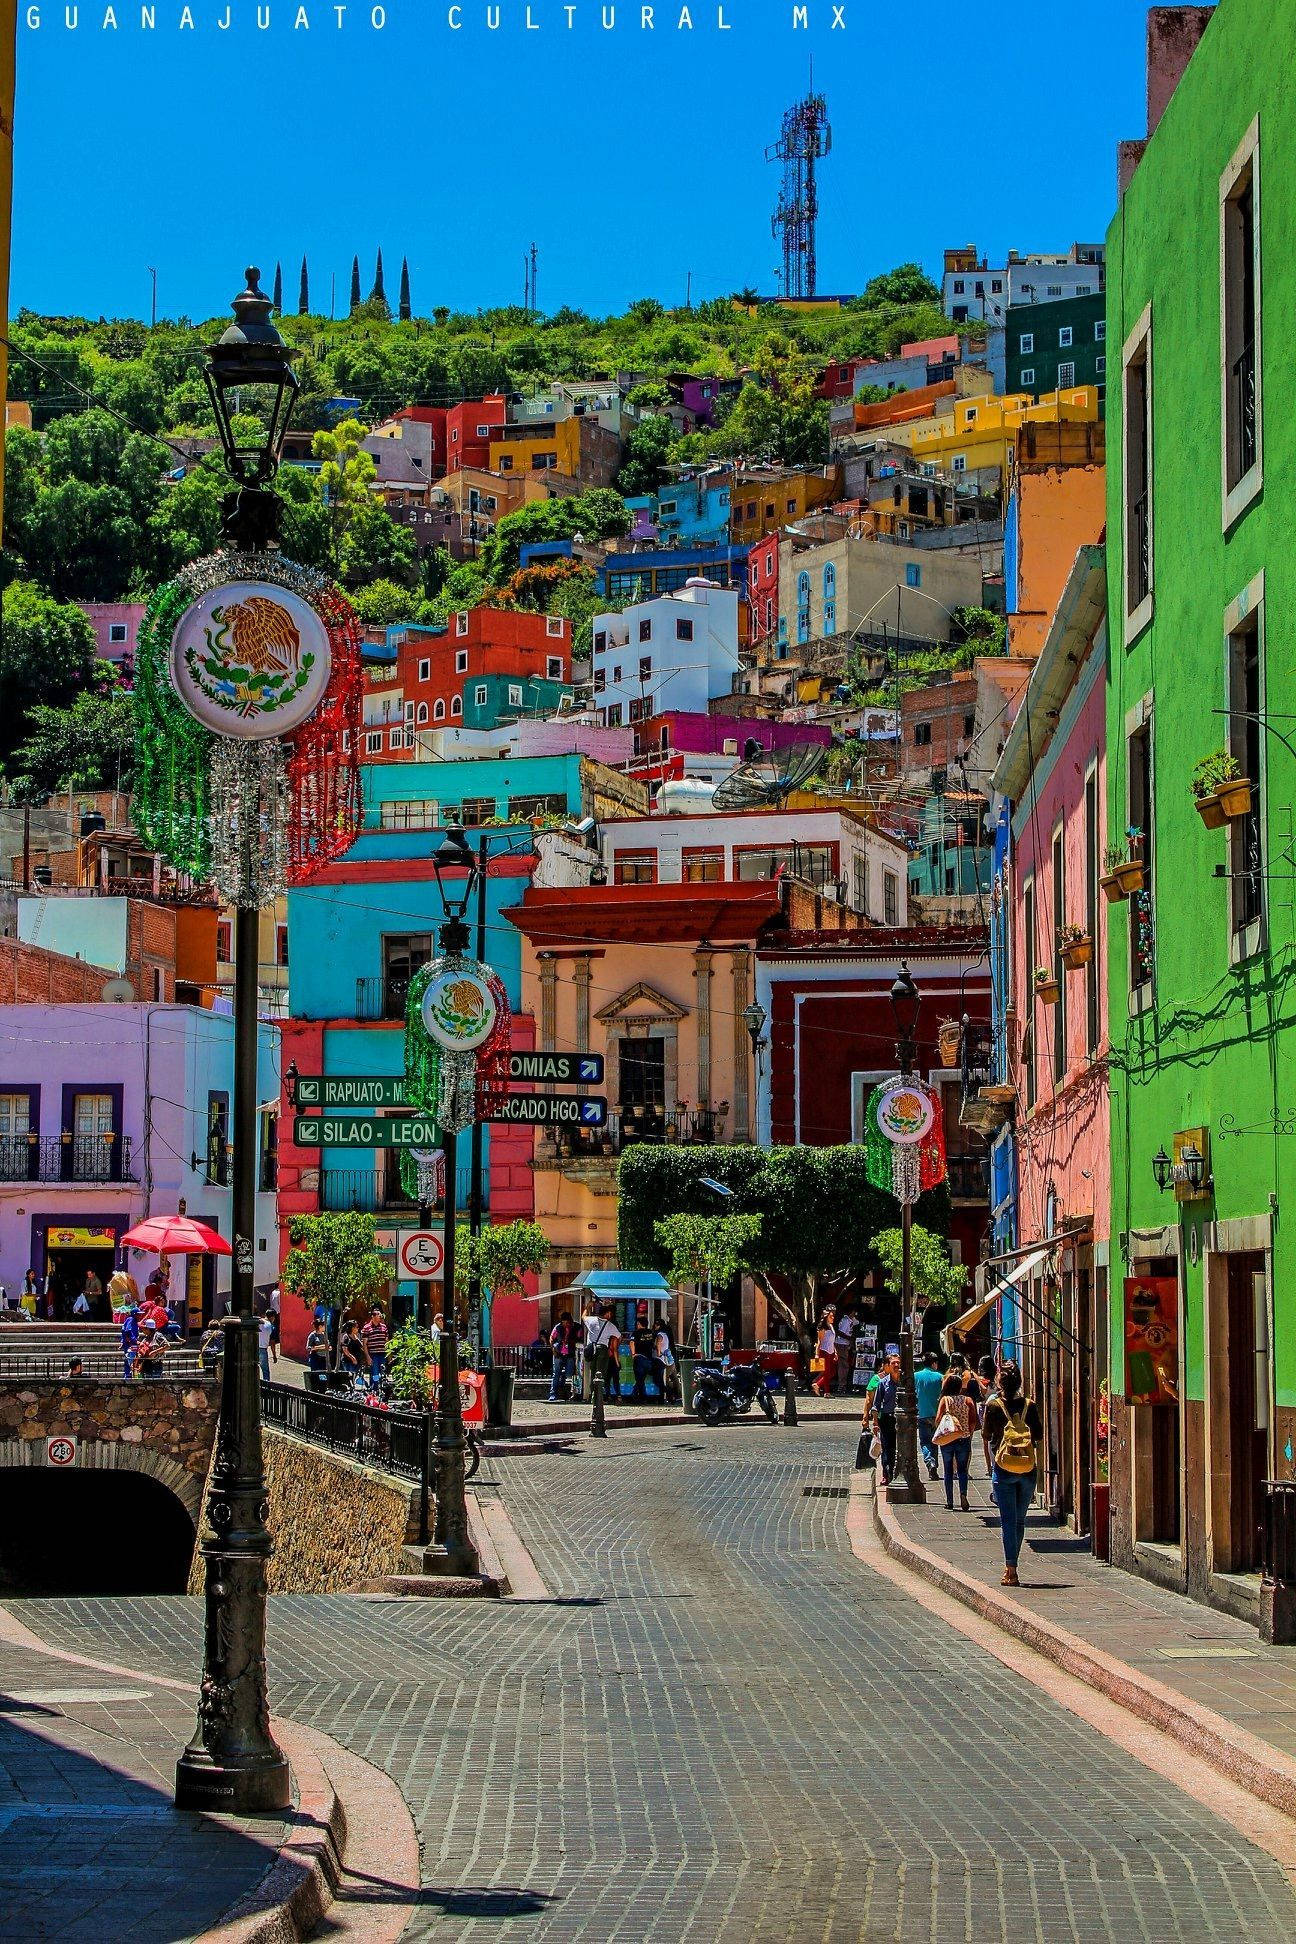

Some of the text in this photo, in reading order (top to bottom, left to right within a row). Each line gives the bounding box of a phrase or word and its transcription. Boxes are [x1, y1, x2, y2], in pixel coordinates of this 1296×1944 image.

[325, 1082, 384, 1102] IRAPUATO
[550, 1101, 582, 1121] HGO.
[323, 1122, 373, 1142] SILAO
[391, 1123, 436, 1143] LEON
[418, 1239, 428, 1251] E
